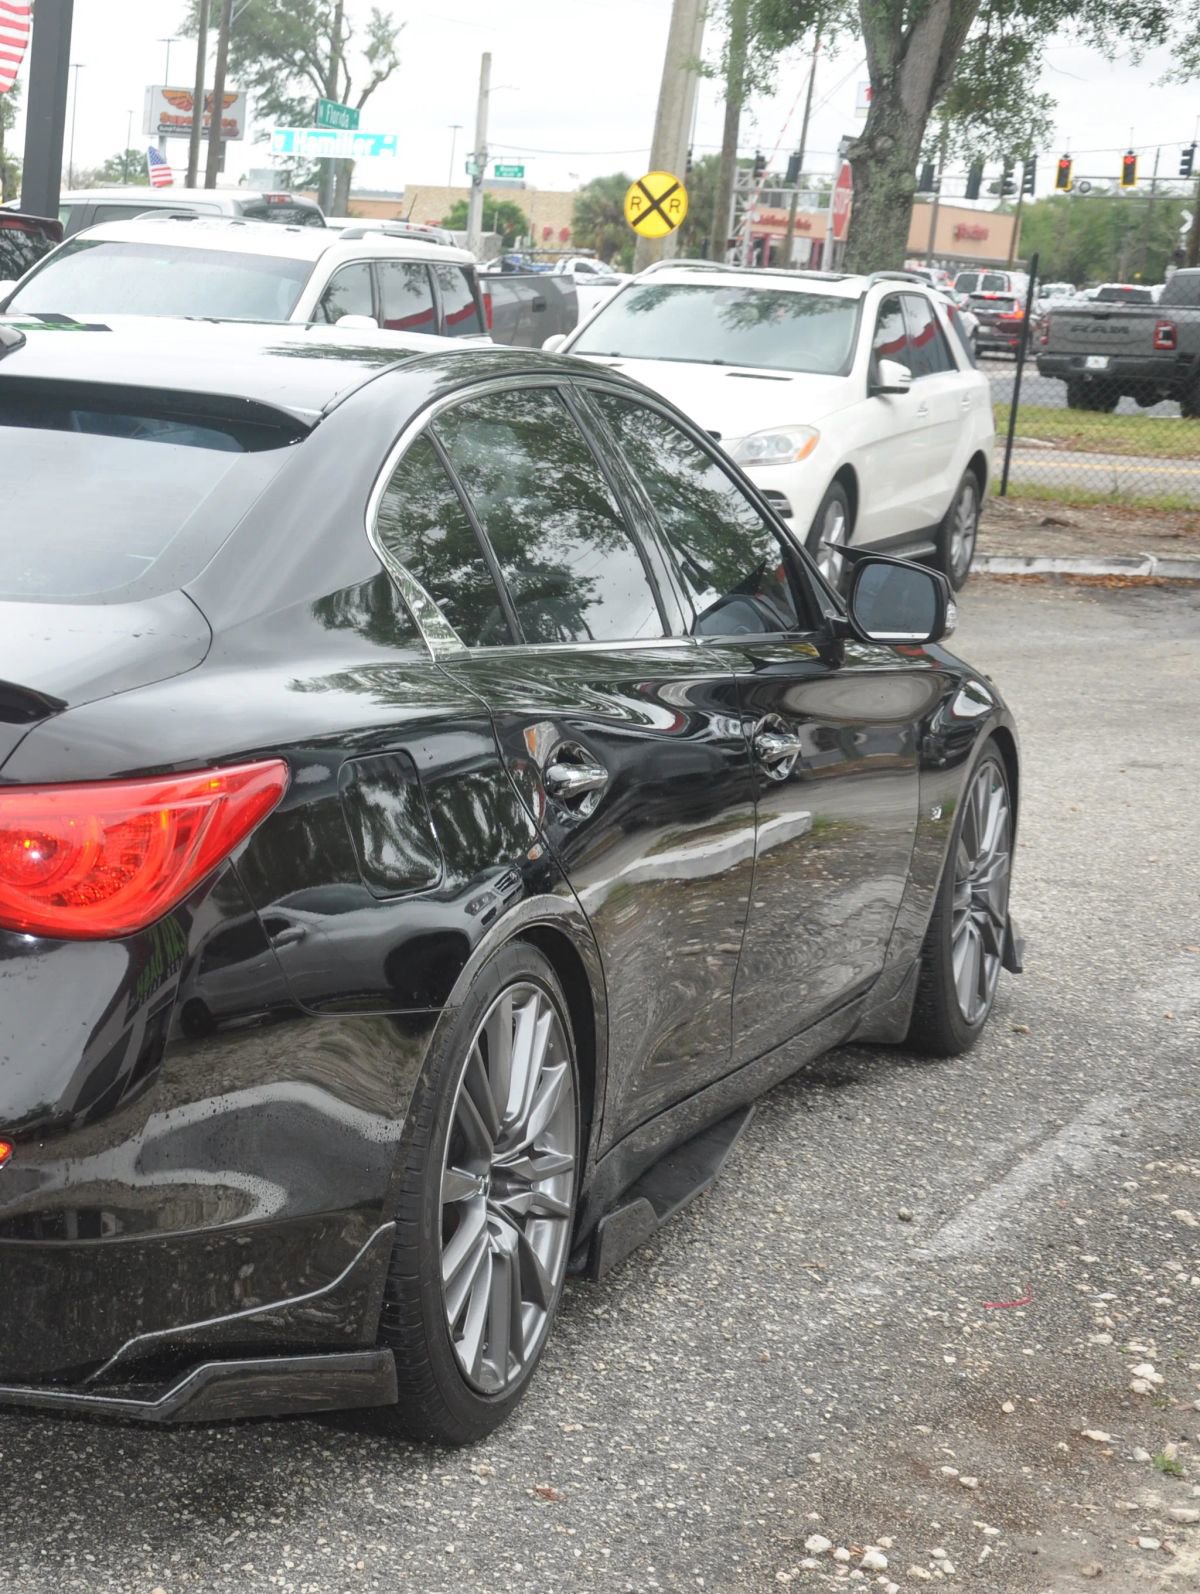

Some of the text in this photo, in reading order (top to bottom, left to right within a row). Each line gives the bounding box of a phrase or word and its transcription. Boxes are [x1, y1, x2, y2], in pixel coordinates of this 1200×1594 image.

[326, 103, 350, 128] Florida
[630, 196, 681, 213] R R
[1070, 325, 1129, 334] RAM
